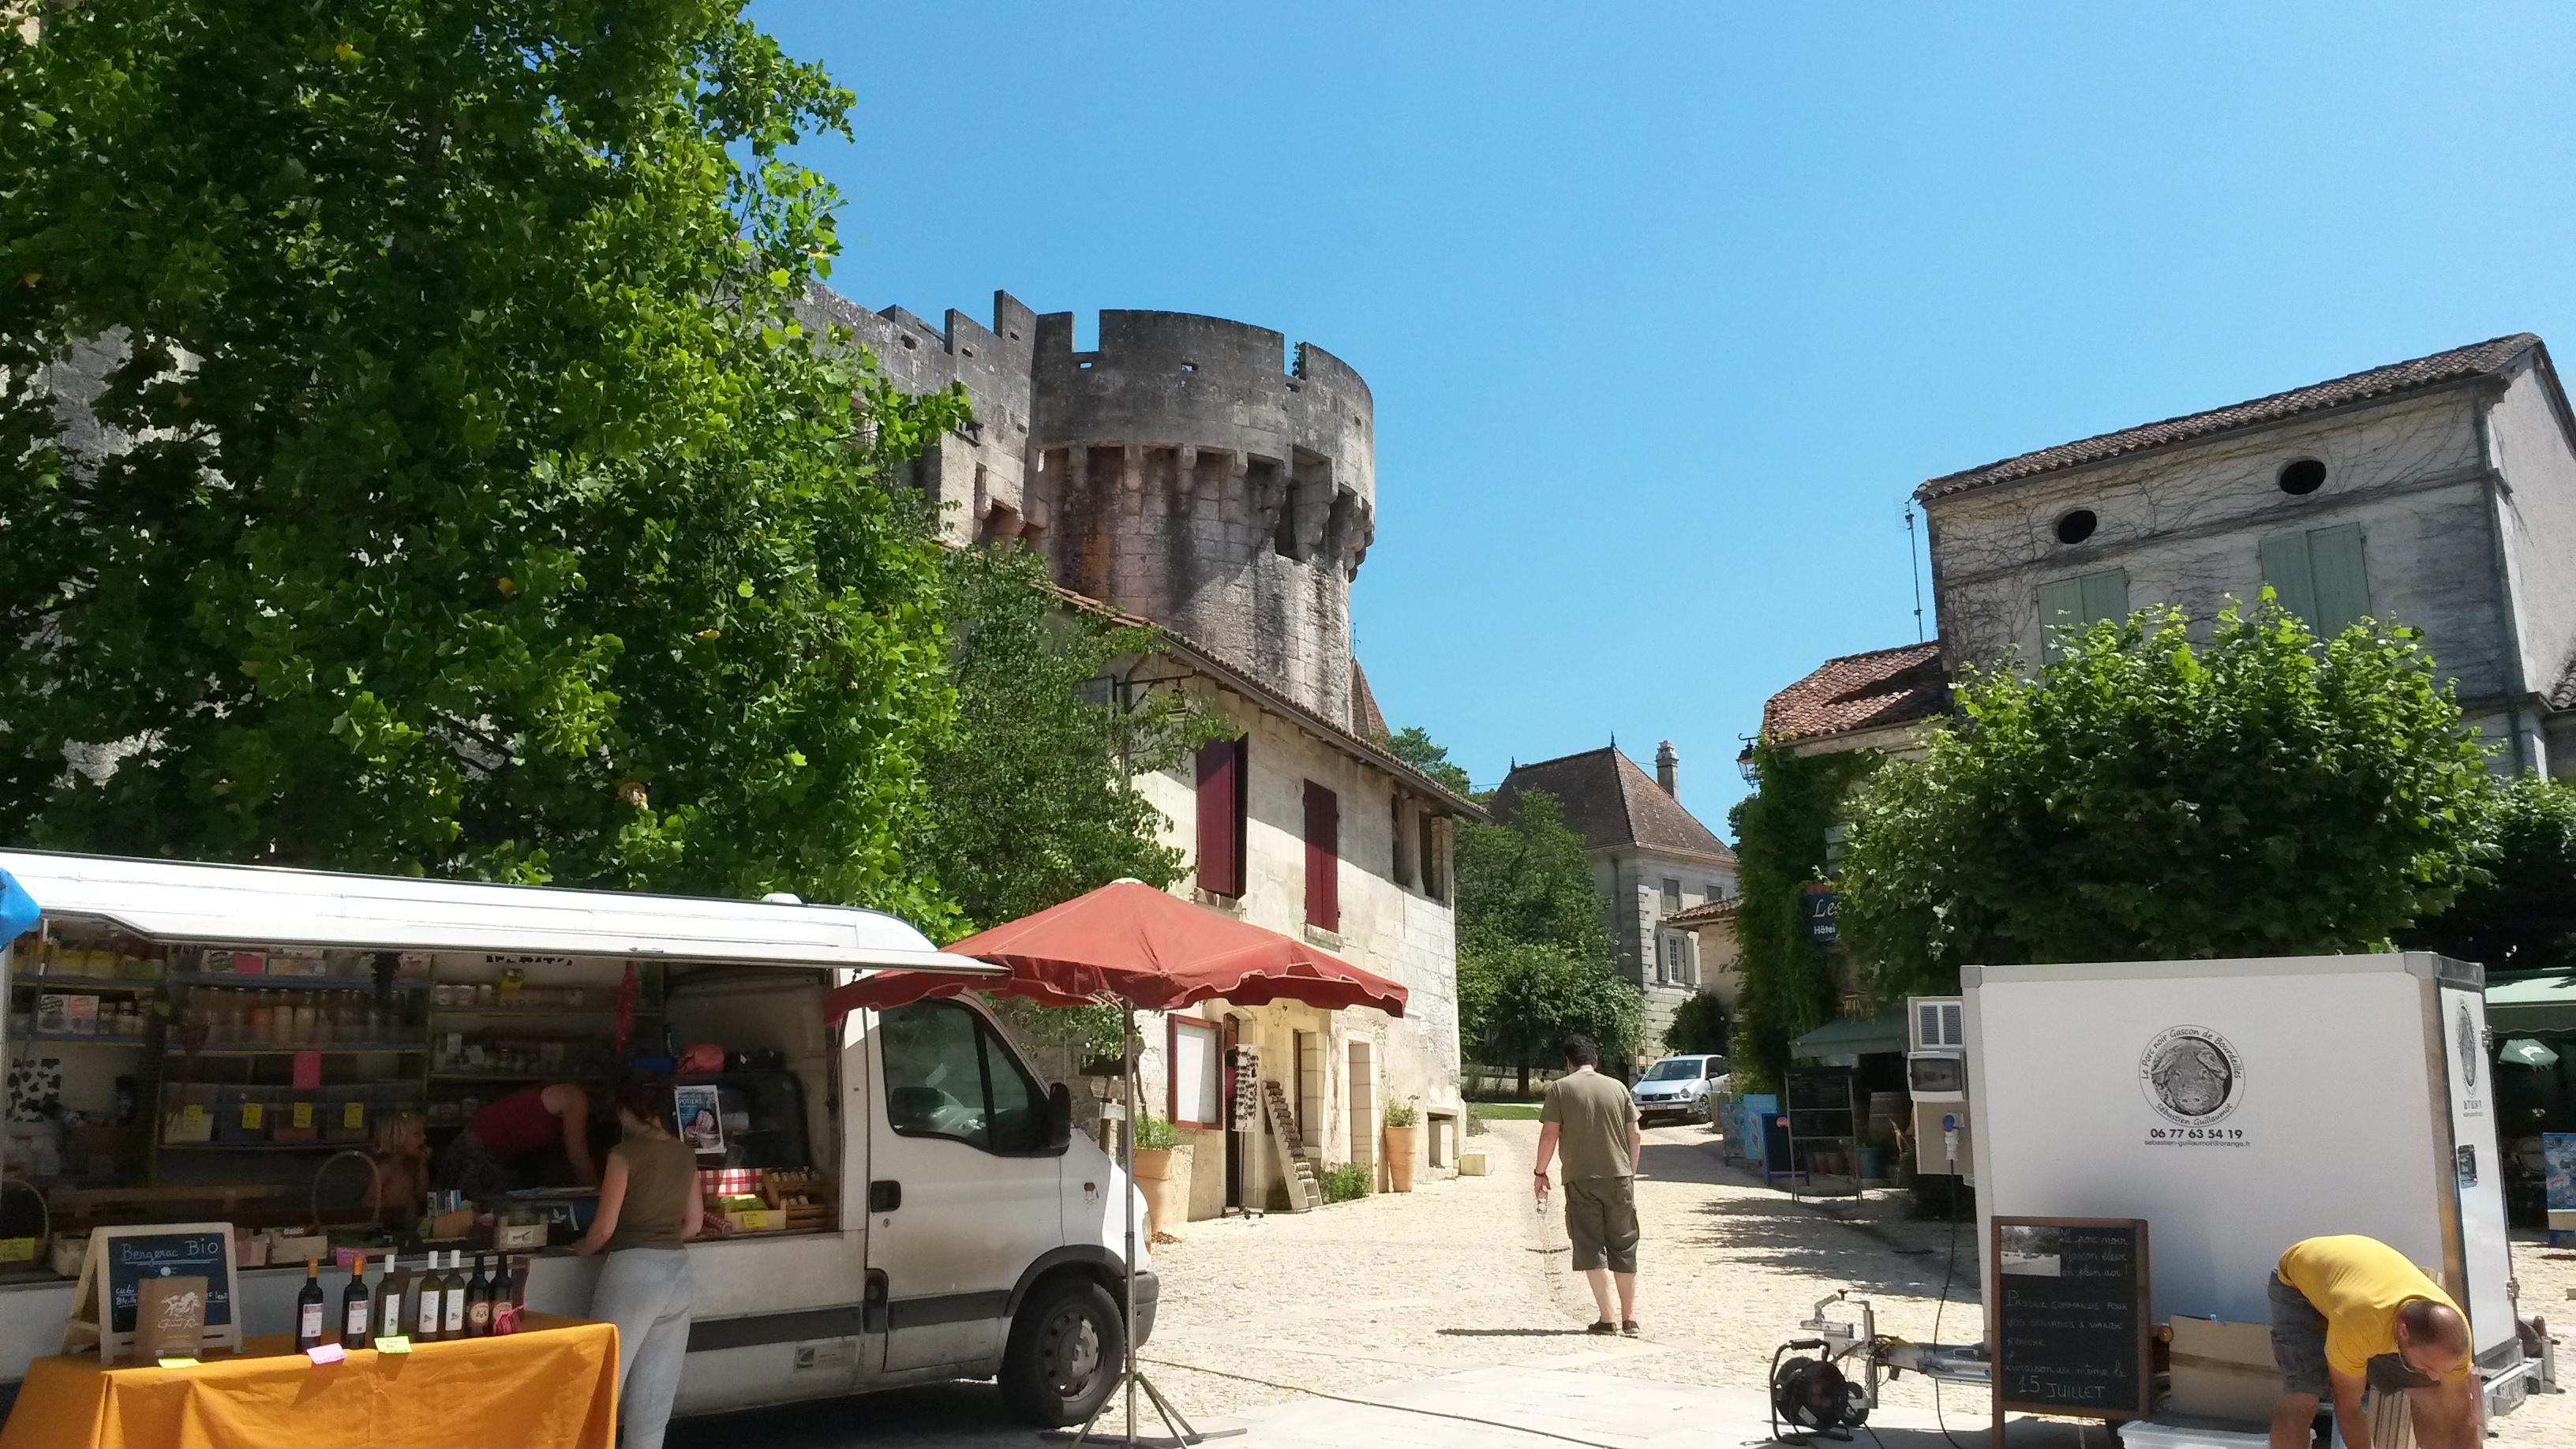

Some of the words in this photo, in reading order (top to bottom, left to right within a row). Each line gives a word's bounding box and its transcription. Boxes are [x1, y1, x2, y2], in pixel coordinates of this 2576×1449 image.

[2170, 1028, 2200, 1038] Gascon
[2202, 1030, 2212, 1040] de
[2154, 1034, 2167, 1049] noir
[2142, 1049, 2155, 1066] Porc
[2214, 1038, 2242, 1080] Bourdeilles
[2141, 1069, 2149, 1080] Le
[2155, 1103, 2191, 1125] Sébastien
[2193, 1103, 2233, 1126] Guillaumot
[2150, 1129, 2166, 1138] 06
[2170, 1129, 2185, 1138] 77
[2188, 1129, 2203, 1139] 63
[2207, 1129, 2223, 1139] 54
[2228, 1129, 2243, 1139] 19
[121, 1243, 178, 1266] Bergerac
[2007, 1318, 2025, 1327] VOS
[2019, 1375, 2041, 1393] 15
[2046, 1383, 2106, 1399] JUILLET
